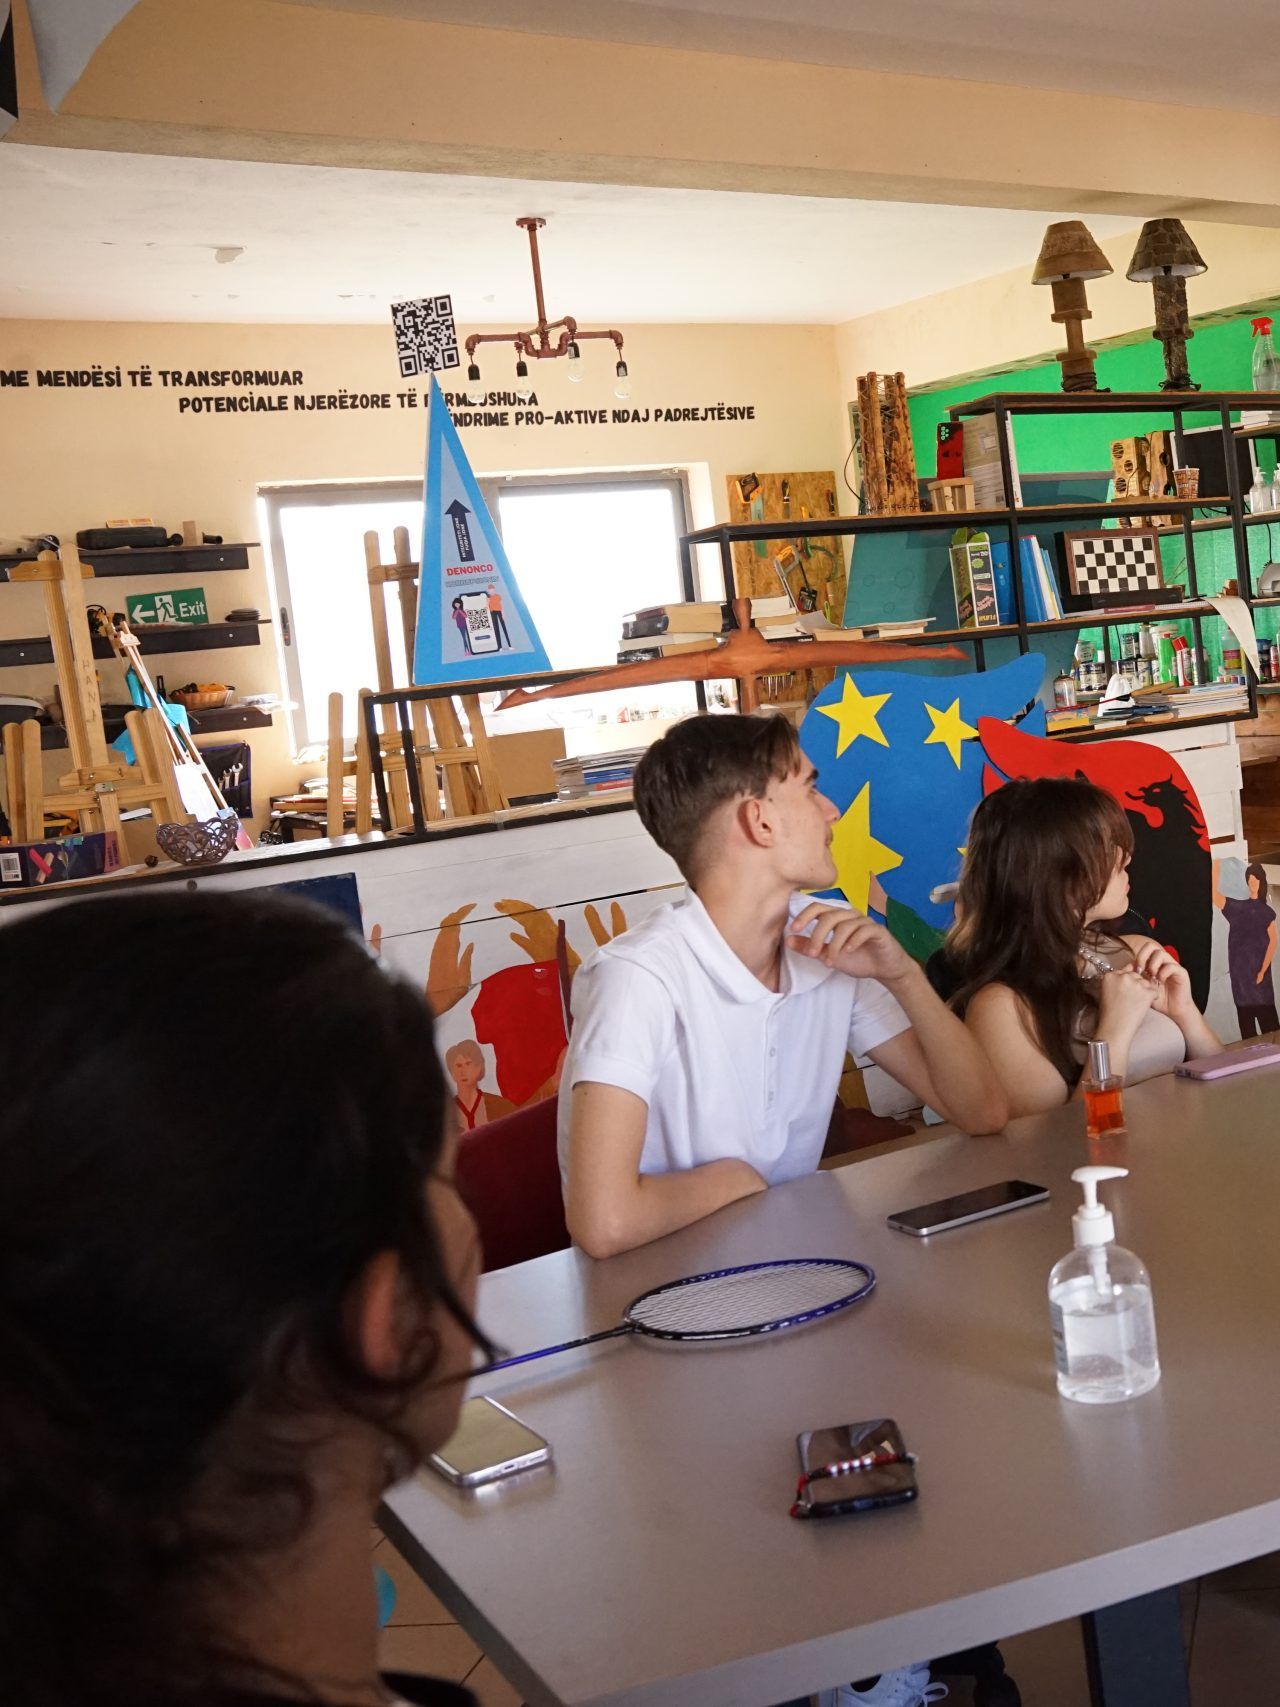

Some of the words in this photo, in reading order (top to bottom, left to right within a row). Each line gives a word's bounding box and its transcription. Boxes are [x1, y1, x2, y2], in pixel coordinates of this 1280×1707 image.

[0, 370, 30, 388] ME
[127, 365, 152, 387] TË
[158, 369, 303, 387] TRANSFORMUAR
[293, 389, 391, 411] NJERËZORE
[396, 388, 418, 408] TË
[514, 409, 608, 426] PRO-AKTIVE
[612, 408, 650, 424] NDAJ
[654, 402, 755, 422] PADREJTËSIVE
[446, 564, 494, 576] DENONCO
[178, 601, 206, 618] Exit
